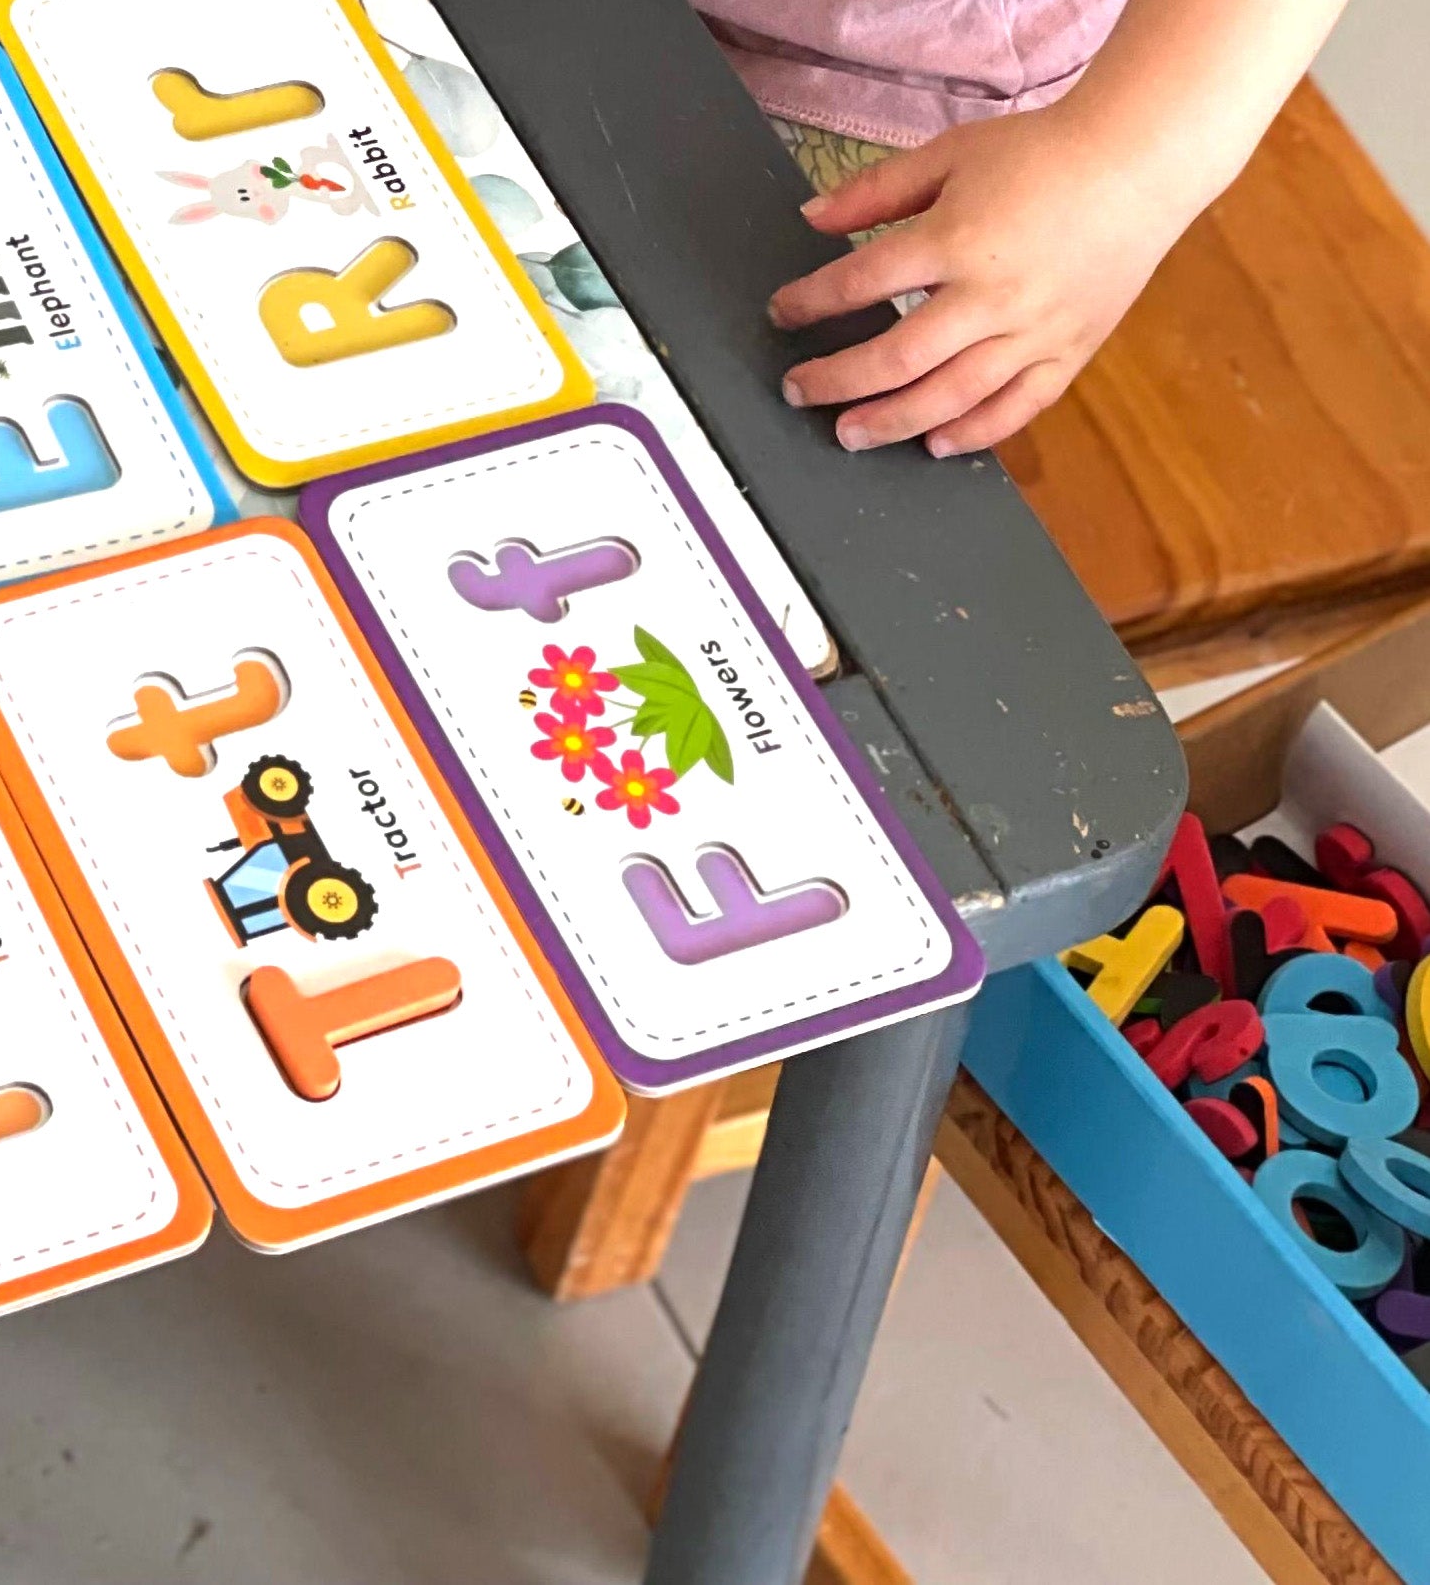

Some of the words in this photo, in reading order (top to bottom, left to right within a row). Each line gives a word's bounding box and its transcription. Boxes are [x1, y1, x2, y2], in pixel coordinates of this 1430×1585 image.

[146, 65, 326, 143] r
[348, 125, 416, 211] Rabbit
[5, 233, 82, 352] Elephant
[257, 235, 458, 369] R
[447, 535, 642, 624] f
[106, 646, 292, 779] t
[701, 639, 783, 757] Flowers
[348, 767, 422, 881] Tractor
[618, 841, 851, 966] F
[239, 955, 464, 1104] T
